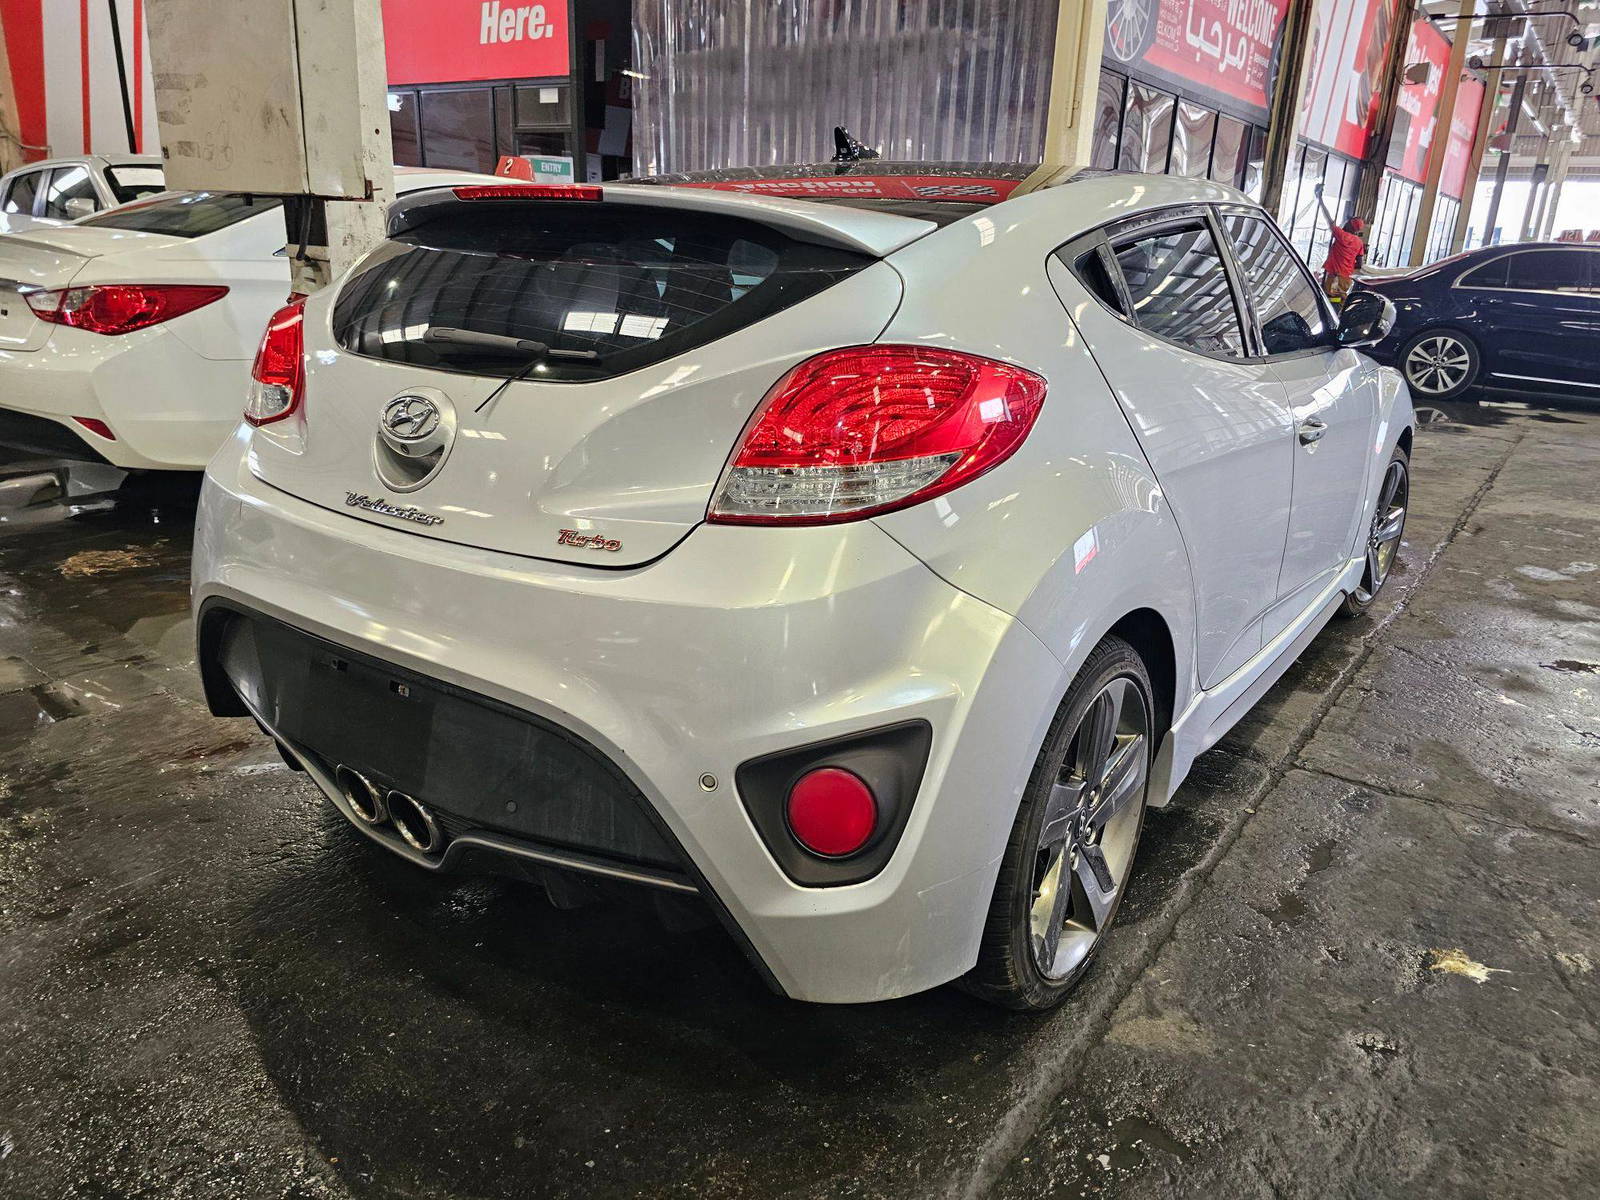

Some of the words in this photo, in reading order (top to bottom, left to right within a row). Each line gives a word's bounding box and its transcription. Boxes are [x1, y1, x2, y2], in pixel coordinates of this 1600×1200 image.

[480, 1, 553, 45] Here.
[1185, 0, 1248, 73] مرحبا
[1227, 0, 1279, 49] WELCOME
[541, 162, 562, 173] ENTRY
[558, 529, 623, 552] Turbo
